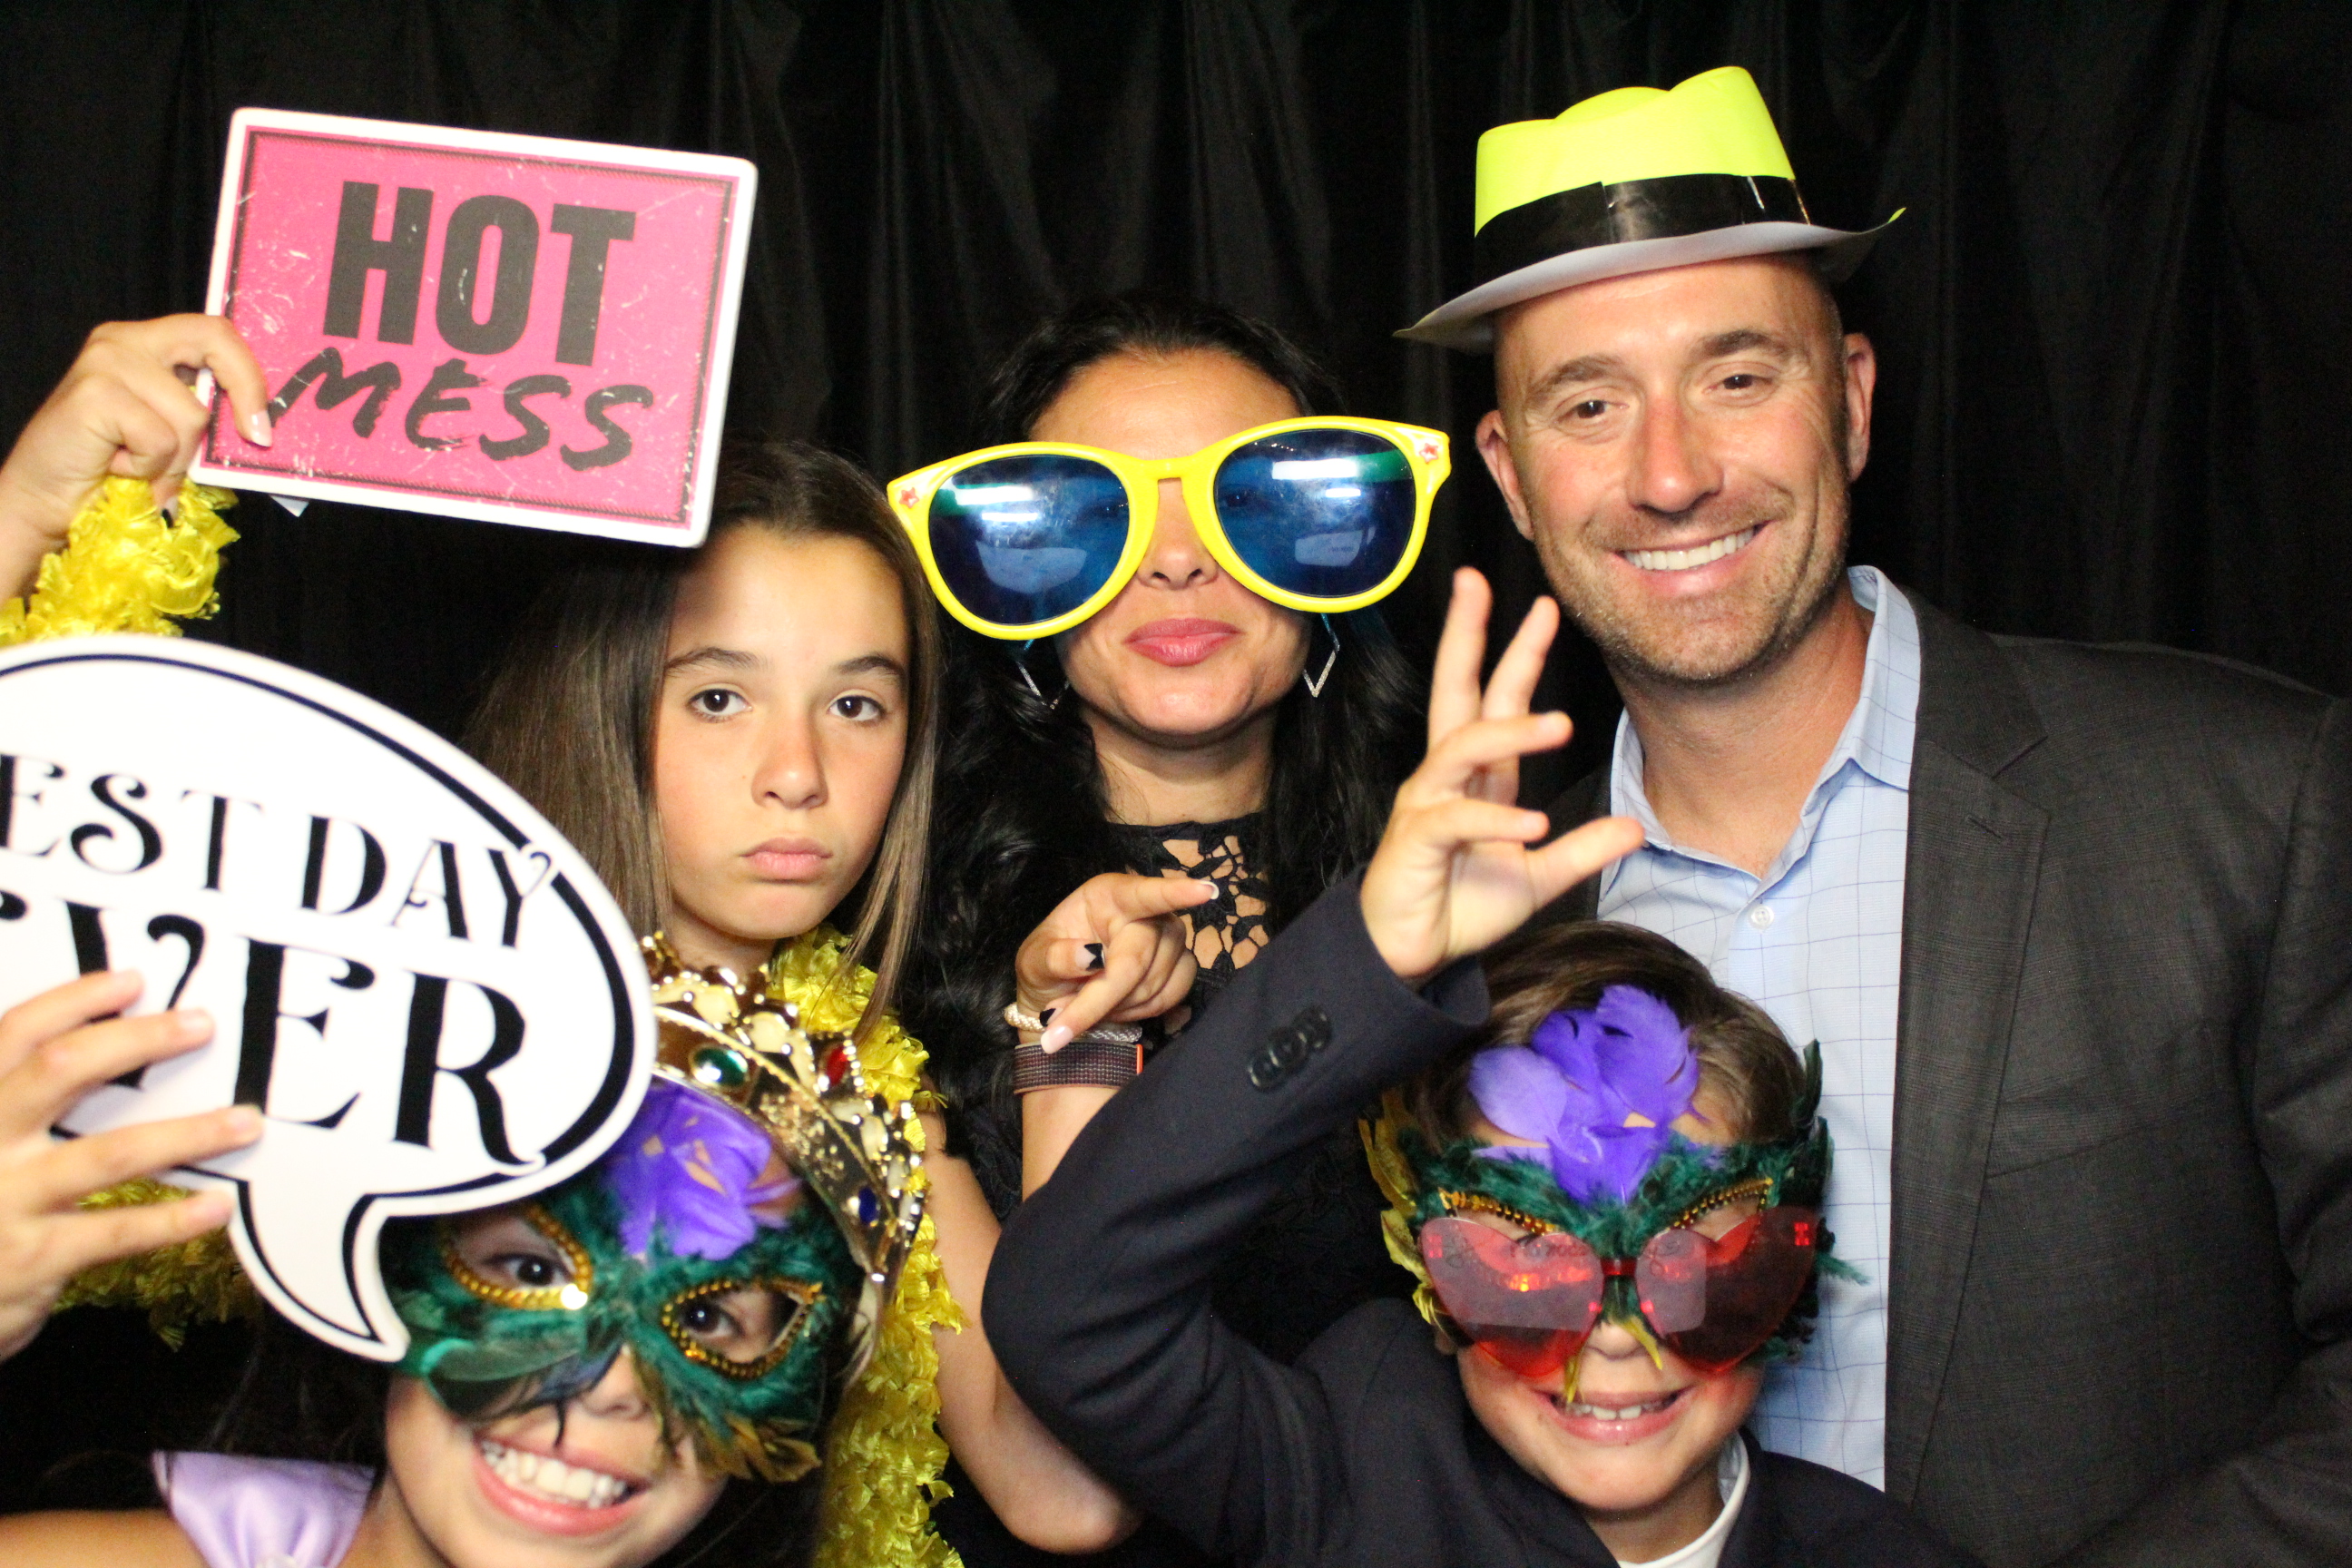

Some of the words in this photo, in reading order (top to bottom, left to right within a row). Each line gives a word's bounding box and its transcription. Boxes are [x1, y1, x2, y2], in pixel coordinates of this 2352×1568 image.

[322, 181, 636, 367] HOT
[270, 347, 653, 471] MESS
[0, 754, 262, 892] EST
[298, 814, 551, 949] DAY
[0, 889, 538, 1166] VER
